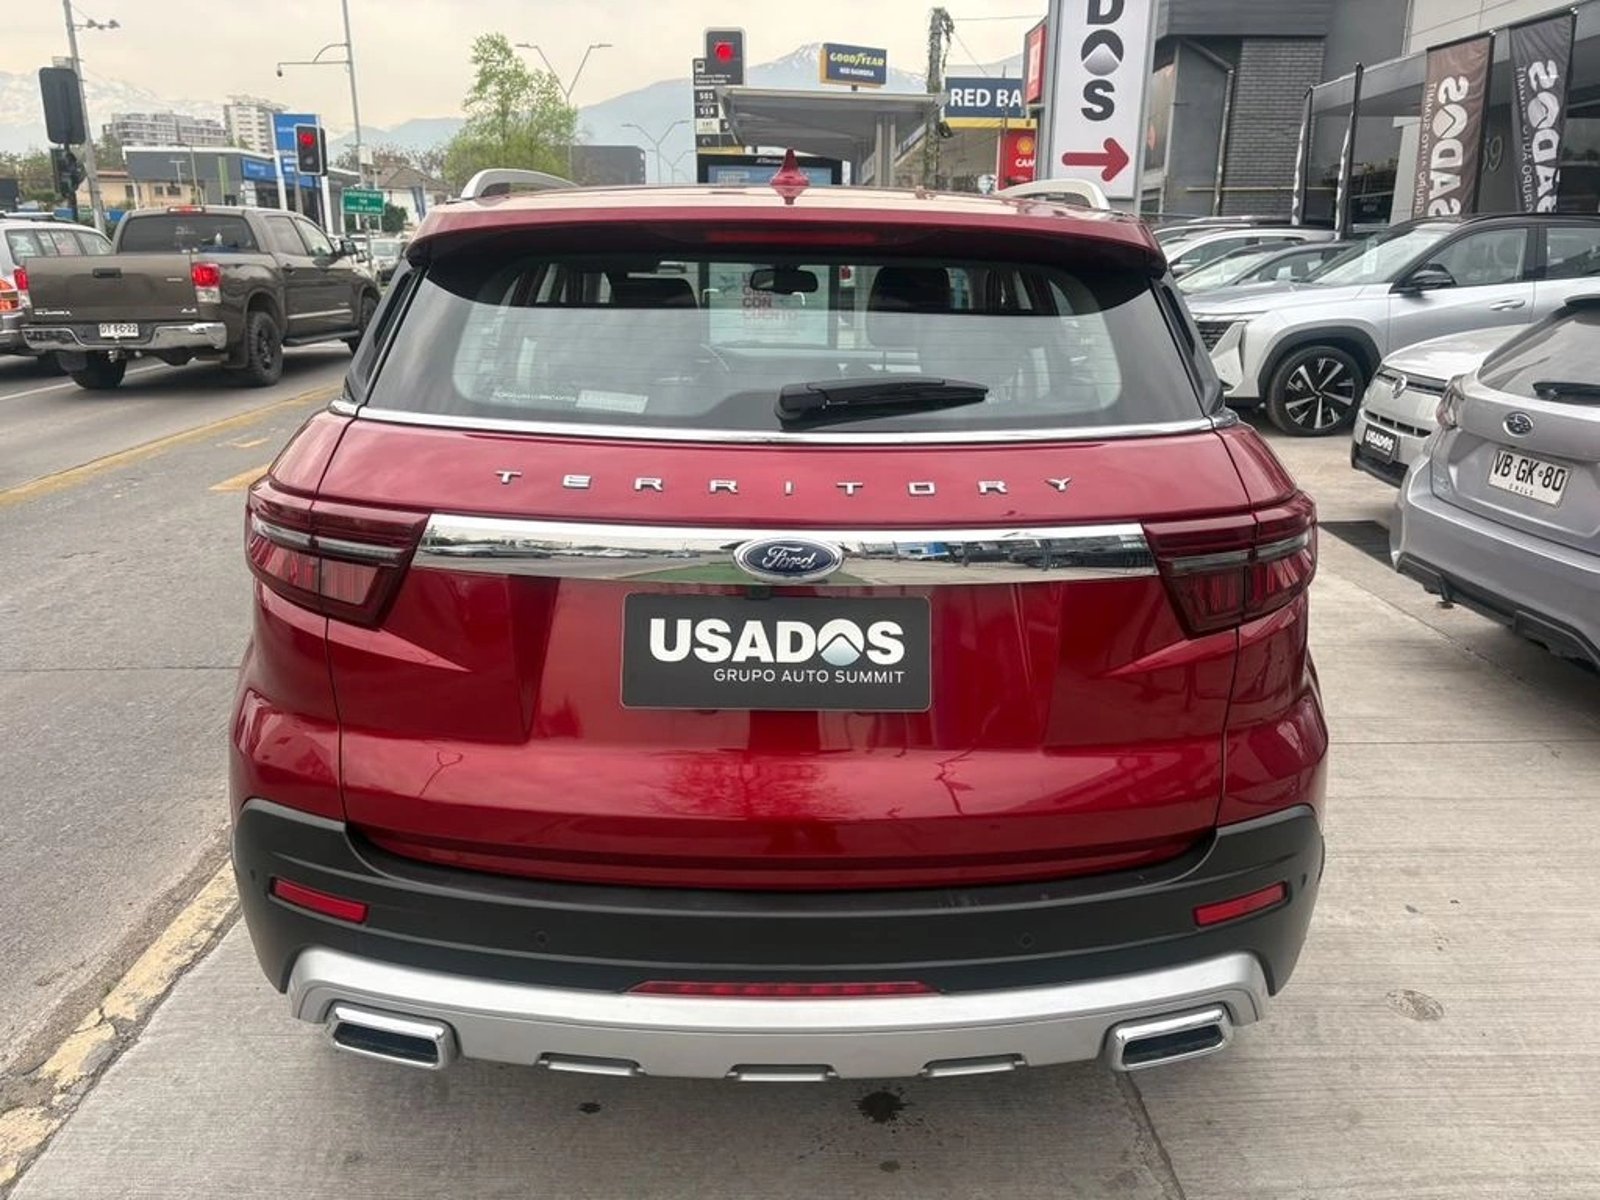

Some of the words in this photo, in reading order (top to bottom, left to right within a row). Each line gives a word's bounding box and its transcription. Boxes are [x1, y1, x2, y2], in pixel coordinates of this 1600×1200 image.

[830, 52, 884, 66] GOODYEAR
[950, 88, 991, 107] RED
[495, 469, 1073, 496] TERRITORY
[762, 546, 817, 569] Ford
[650, 618, 905, 666] USADOS
[713, 668, 776, 682] GRUPO
[781, 669, 829, 683] AUTO
[835, 670, 905, 683] SUMMIT
